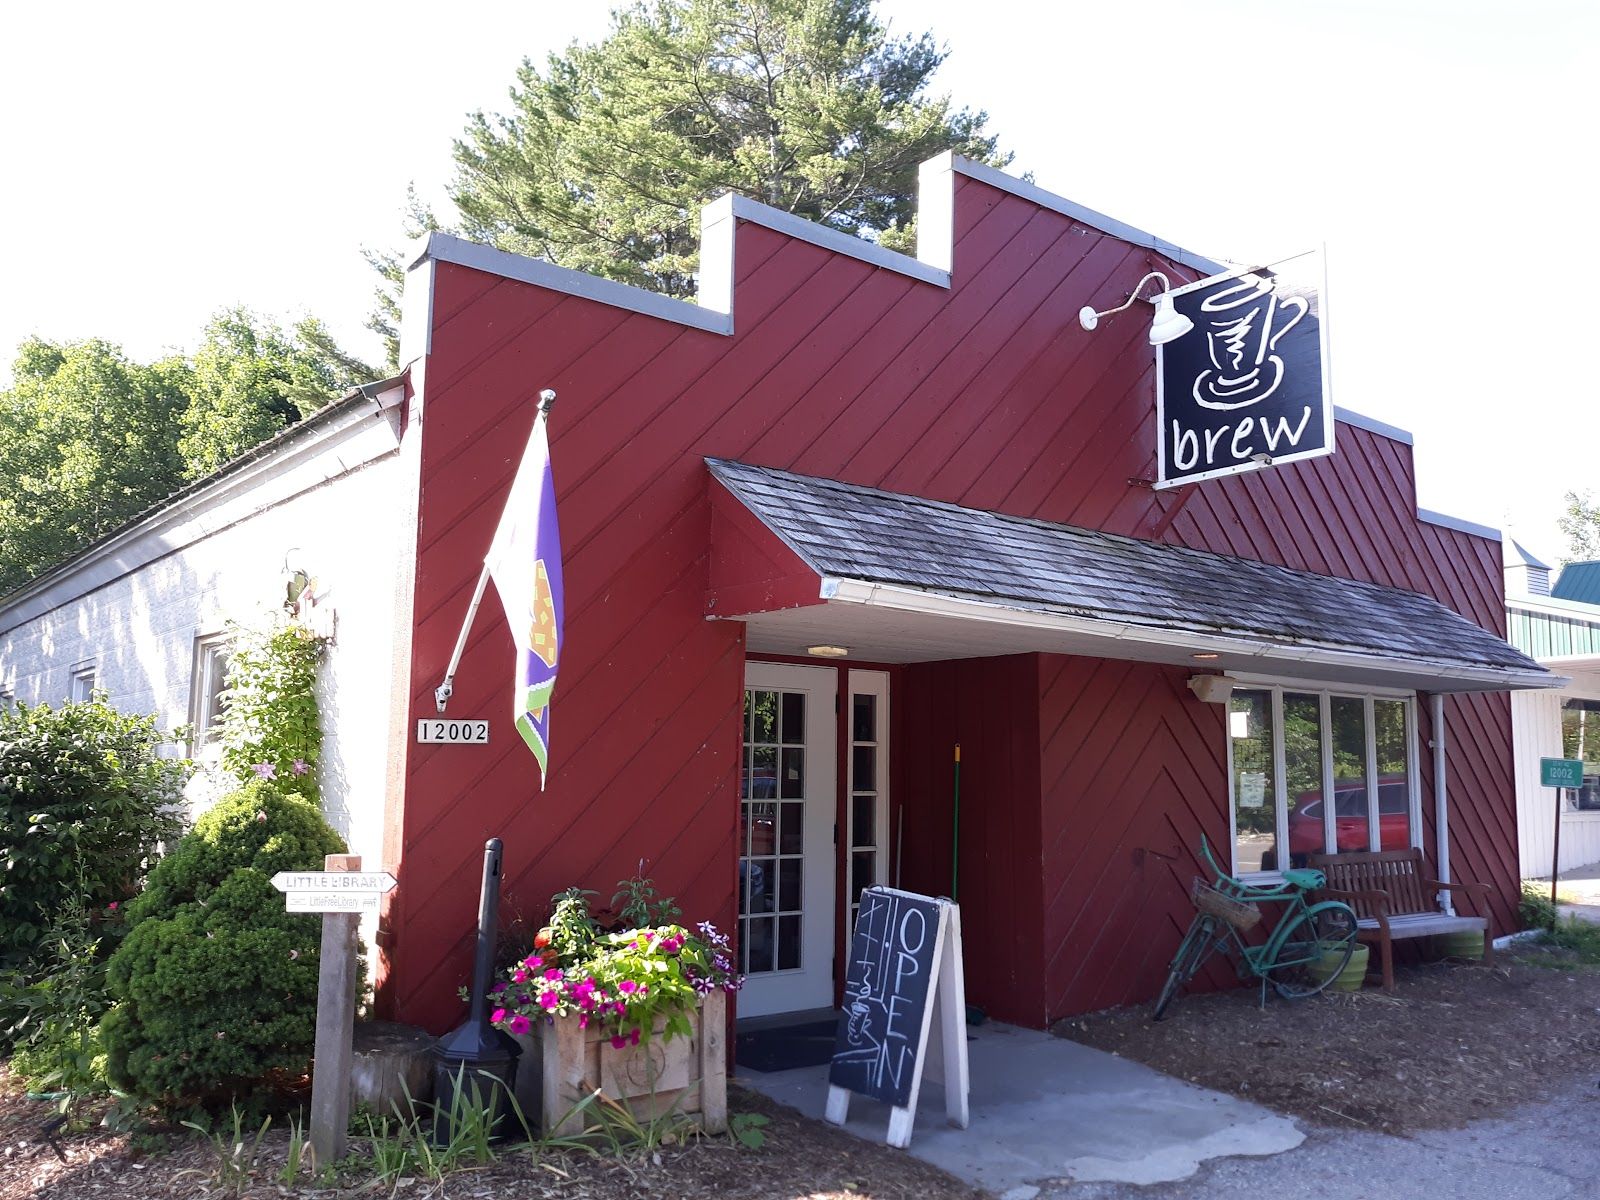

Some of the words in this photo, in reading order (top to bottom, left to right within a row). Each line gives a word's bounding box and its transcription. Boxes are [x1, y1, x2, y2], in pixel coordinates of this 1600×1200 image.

[1173, 406, 1311, 470] brew
[423, 723, 486, 740] 12002
[1550, 767, 1573, 779] 12002
[286, 876, 327, 887] LITTLE
[331, 876, 386, 888] LIBRARY
[876, 907, 926, 1089] OPEN
